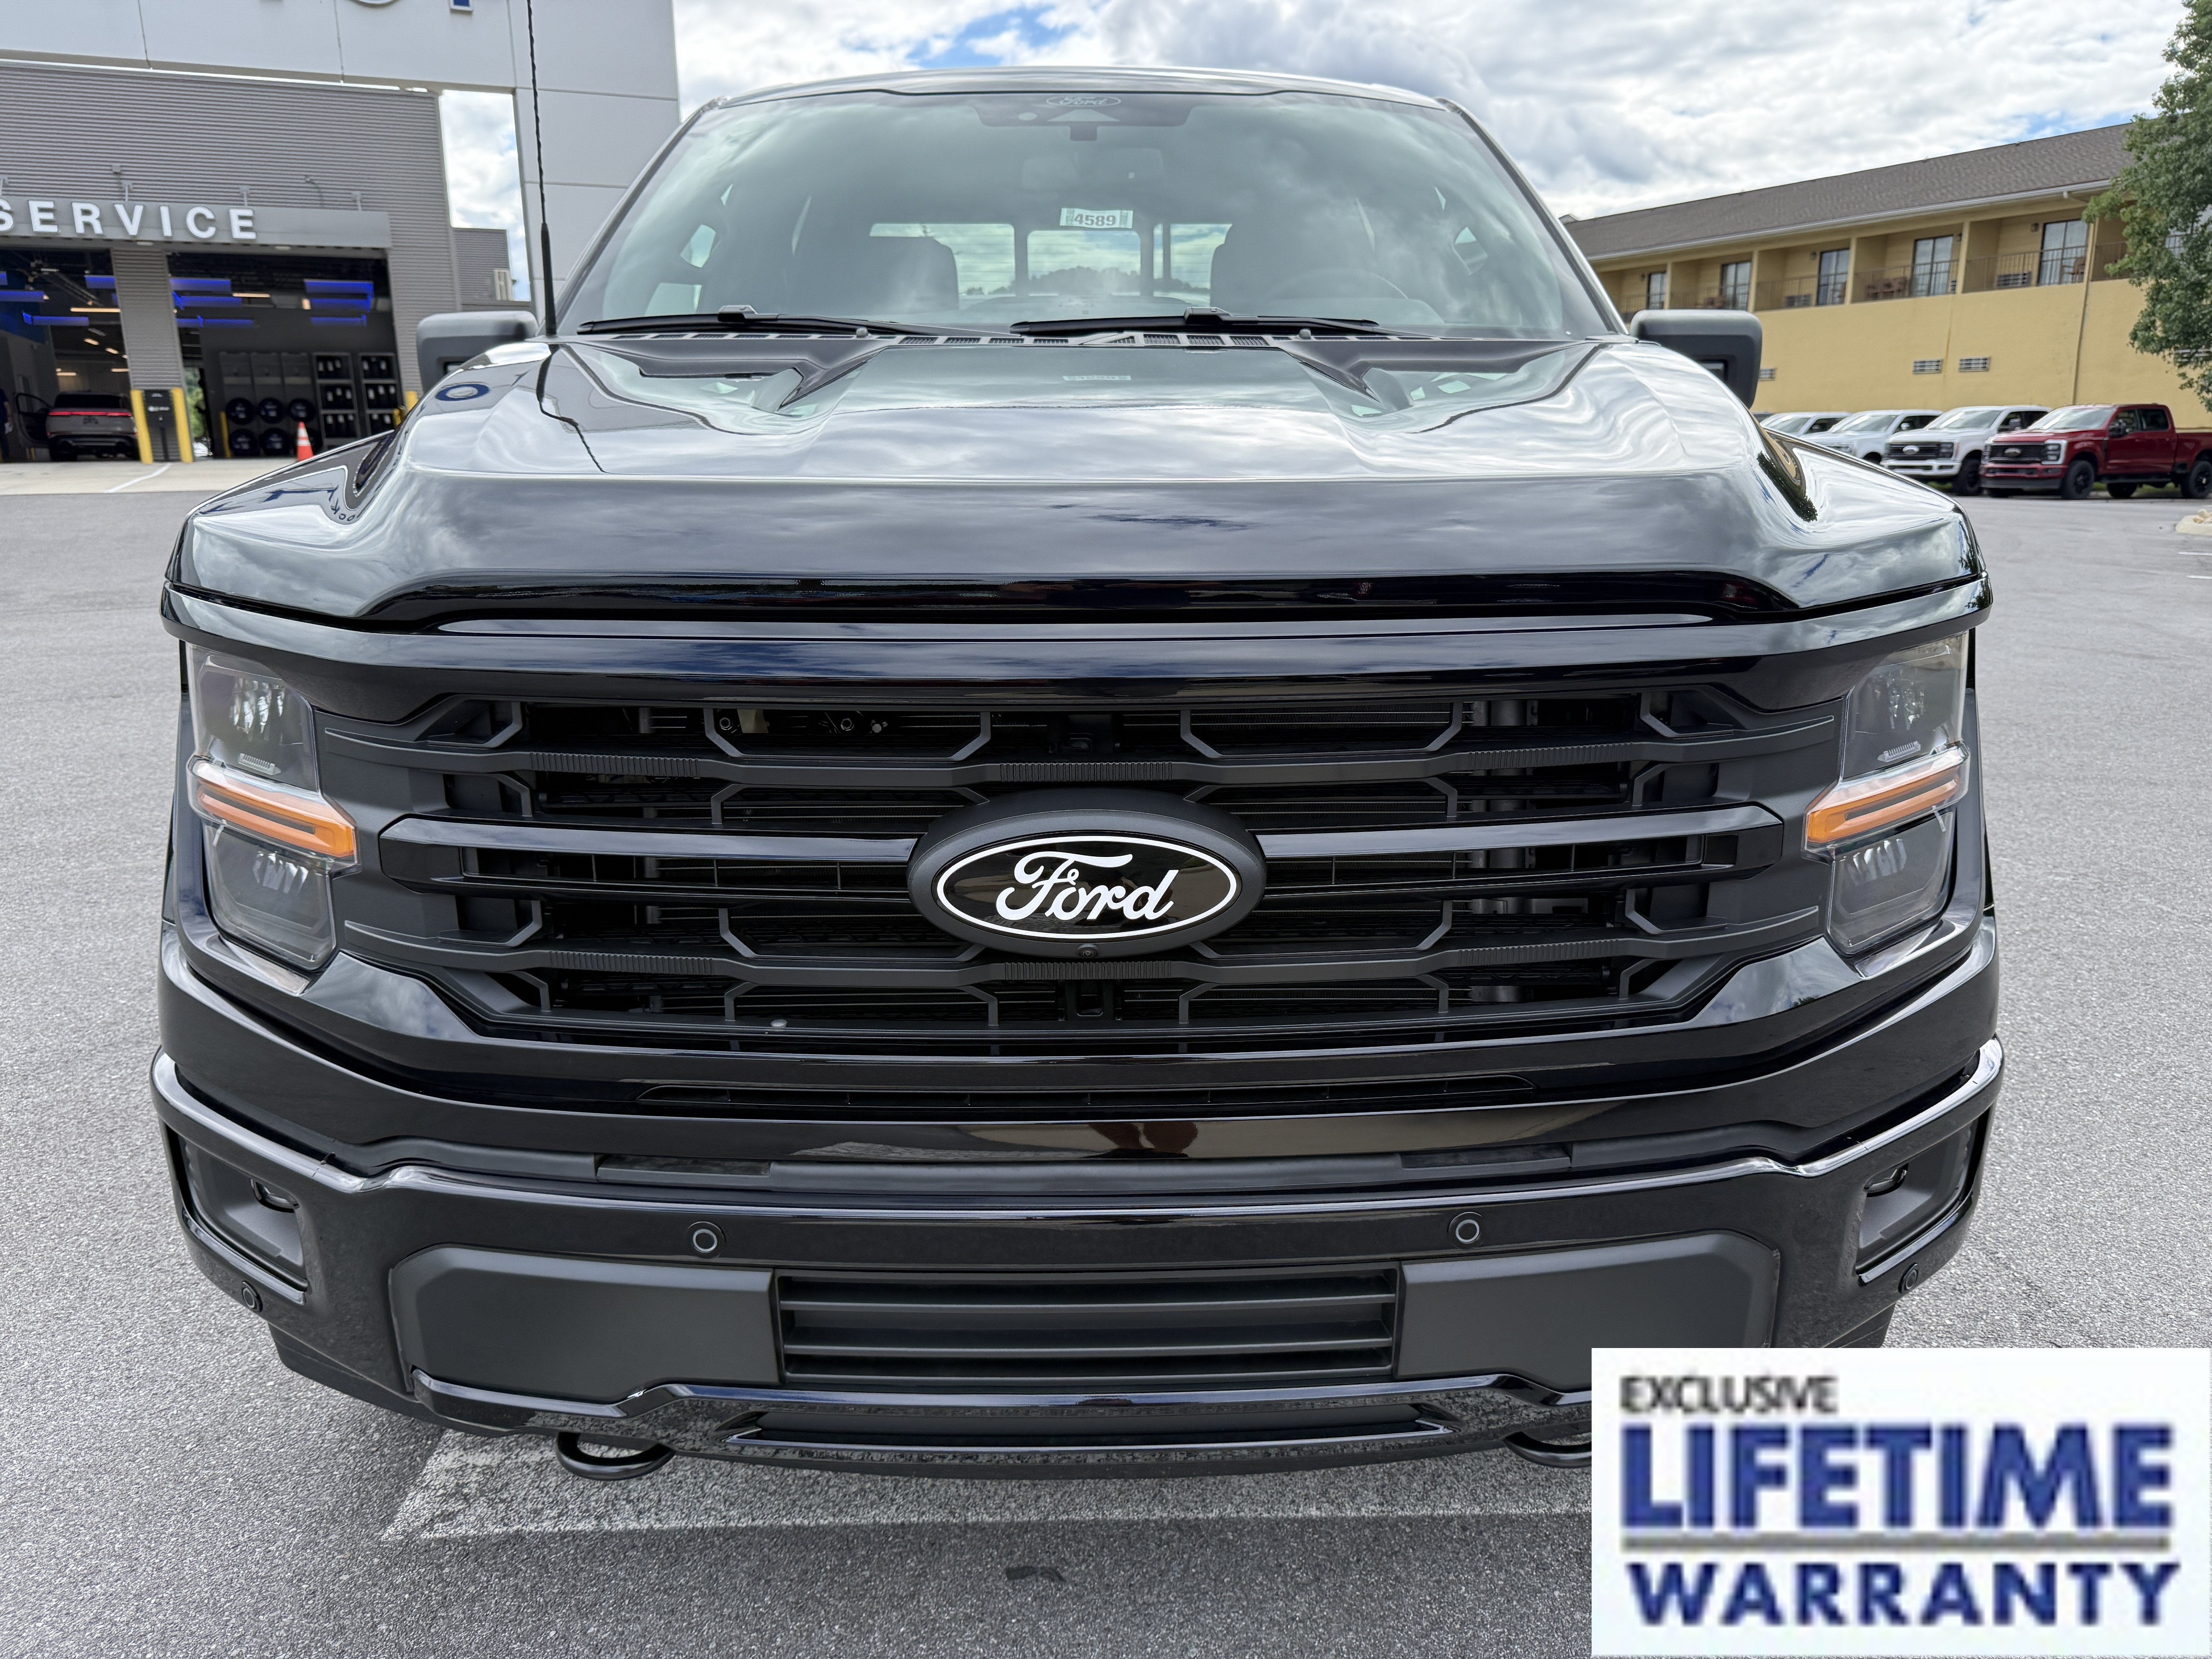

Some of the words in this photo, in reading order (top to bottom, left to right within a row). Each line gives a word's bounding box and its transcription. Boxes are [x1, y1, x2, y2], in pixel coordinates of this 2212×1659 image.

[1059, 96, 1108, 105] Ford
[1074, 213, 1116, 227] 4589
[996, 851, 1179, 921] Ford
